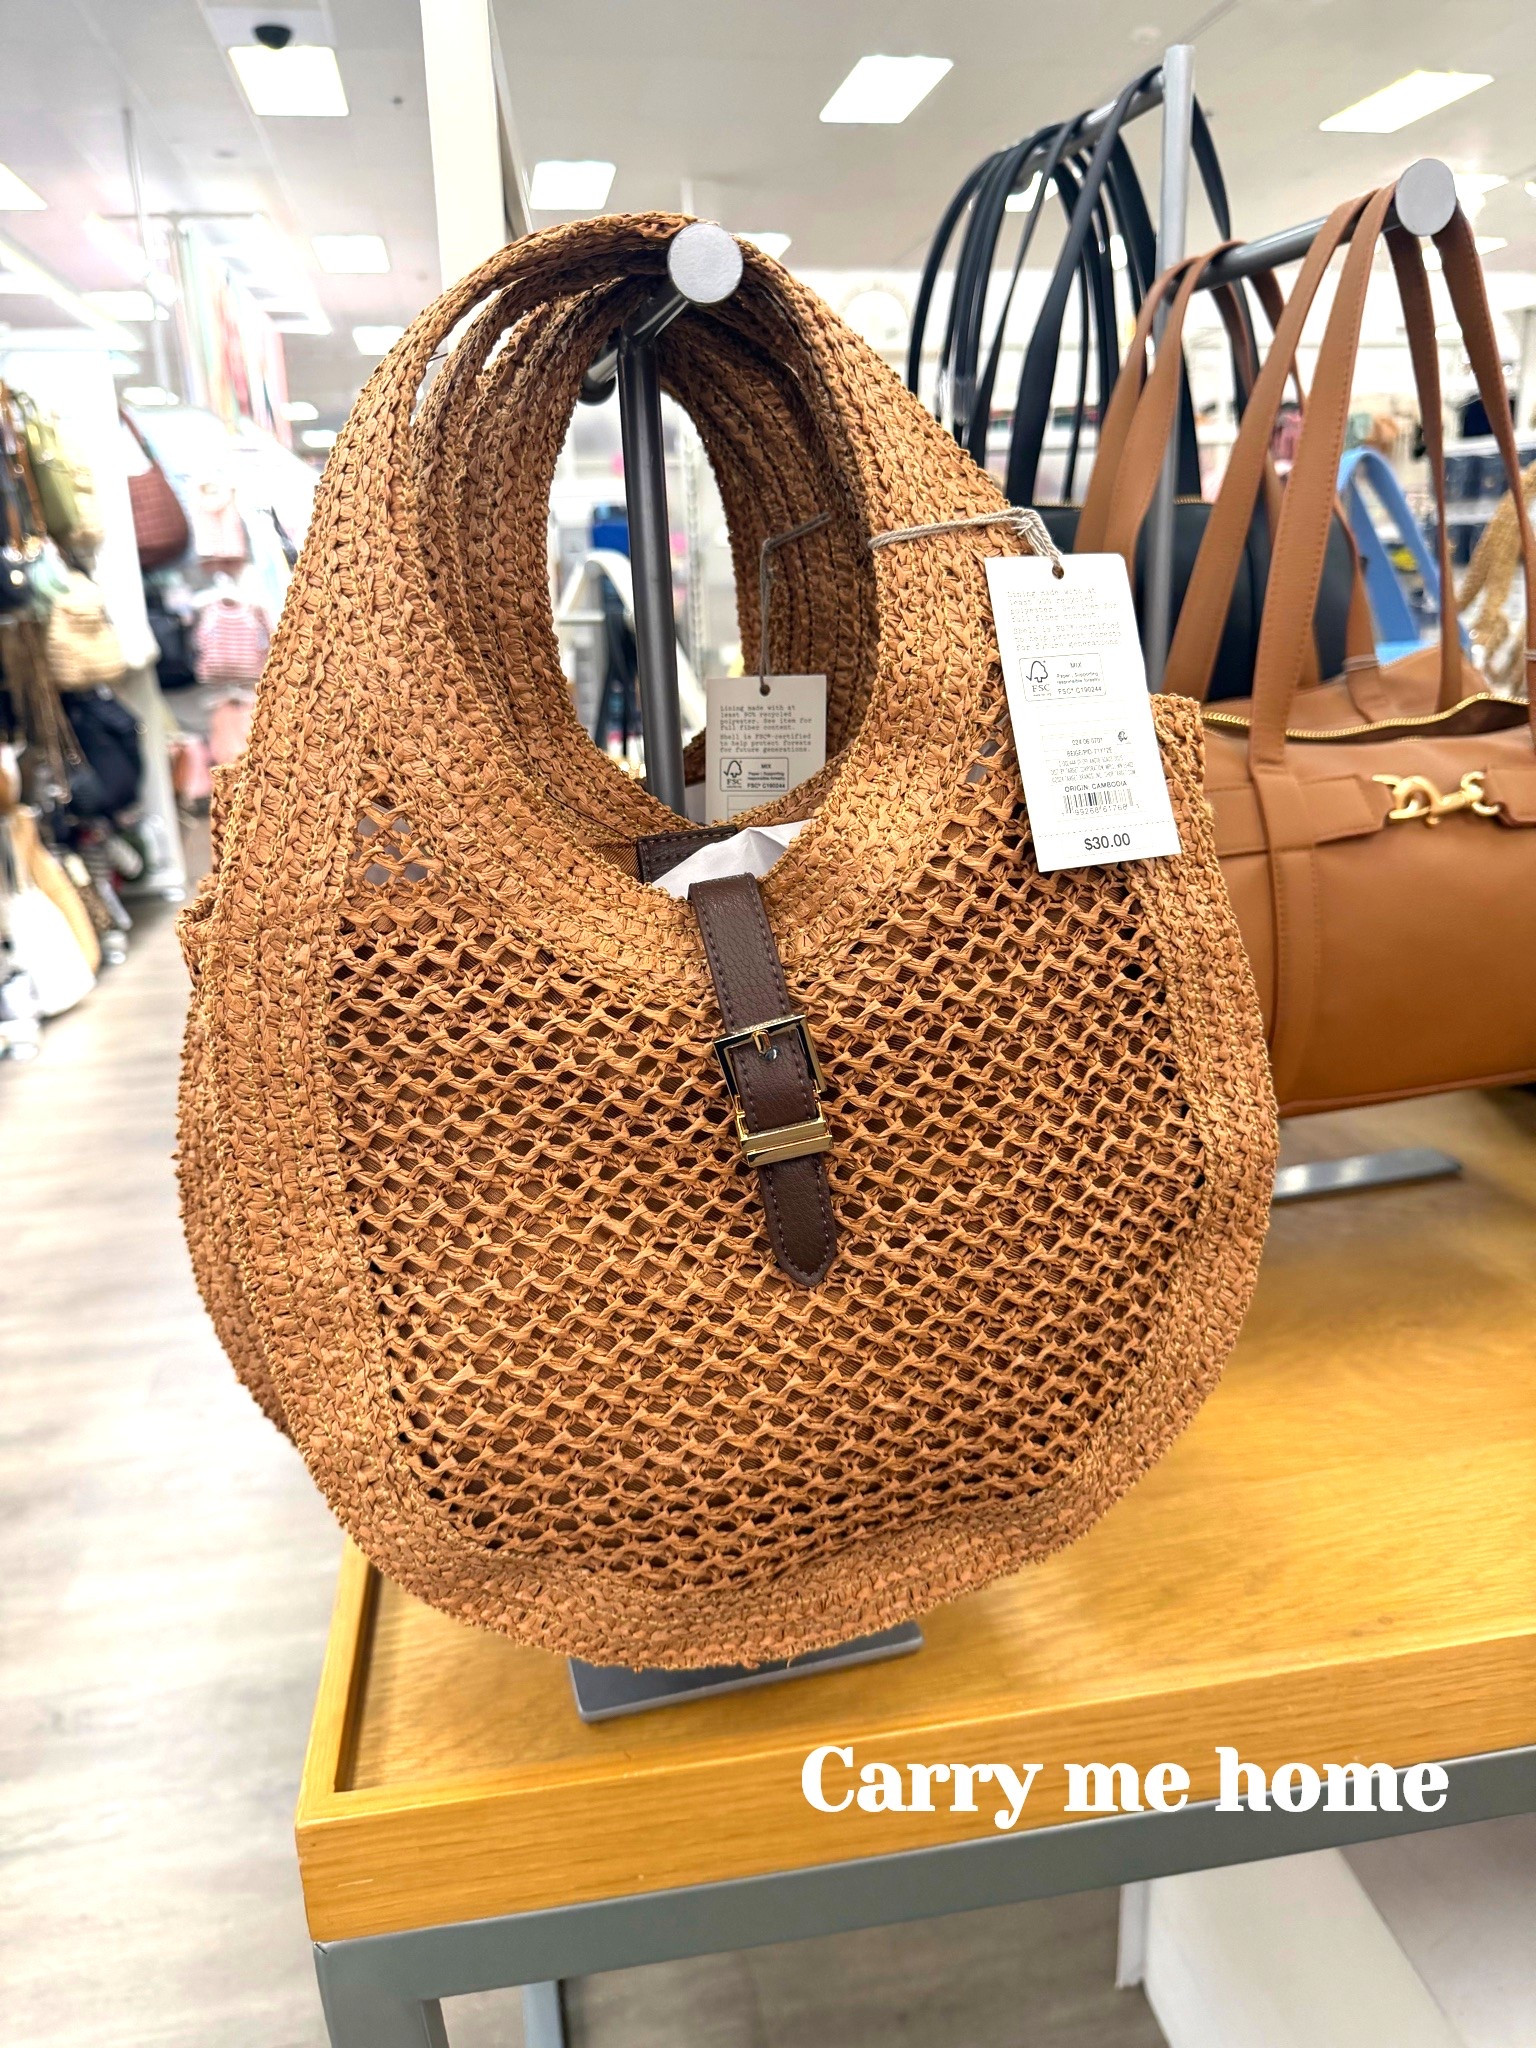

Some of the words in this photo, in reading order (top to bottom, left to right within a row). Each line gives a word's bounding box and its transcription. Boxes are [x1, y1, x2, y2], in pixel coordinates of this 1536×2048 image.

[1032, 684, 1050, 693] FSC
[1092, 780, 1127, 789] CAMBODIA
[1084, 833, 1131, 851] $30.00
